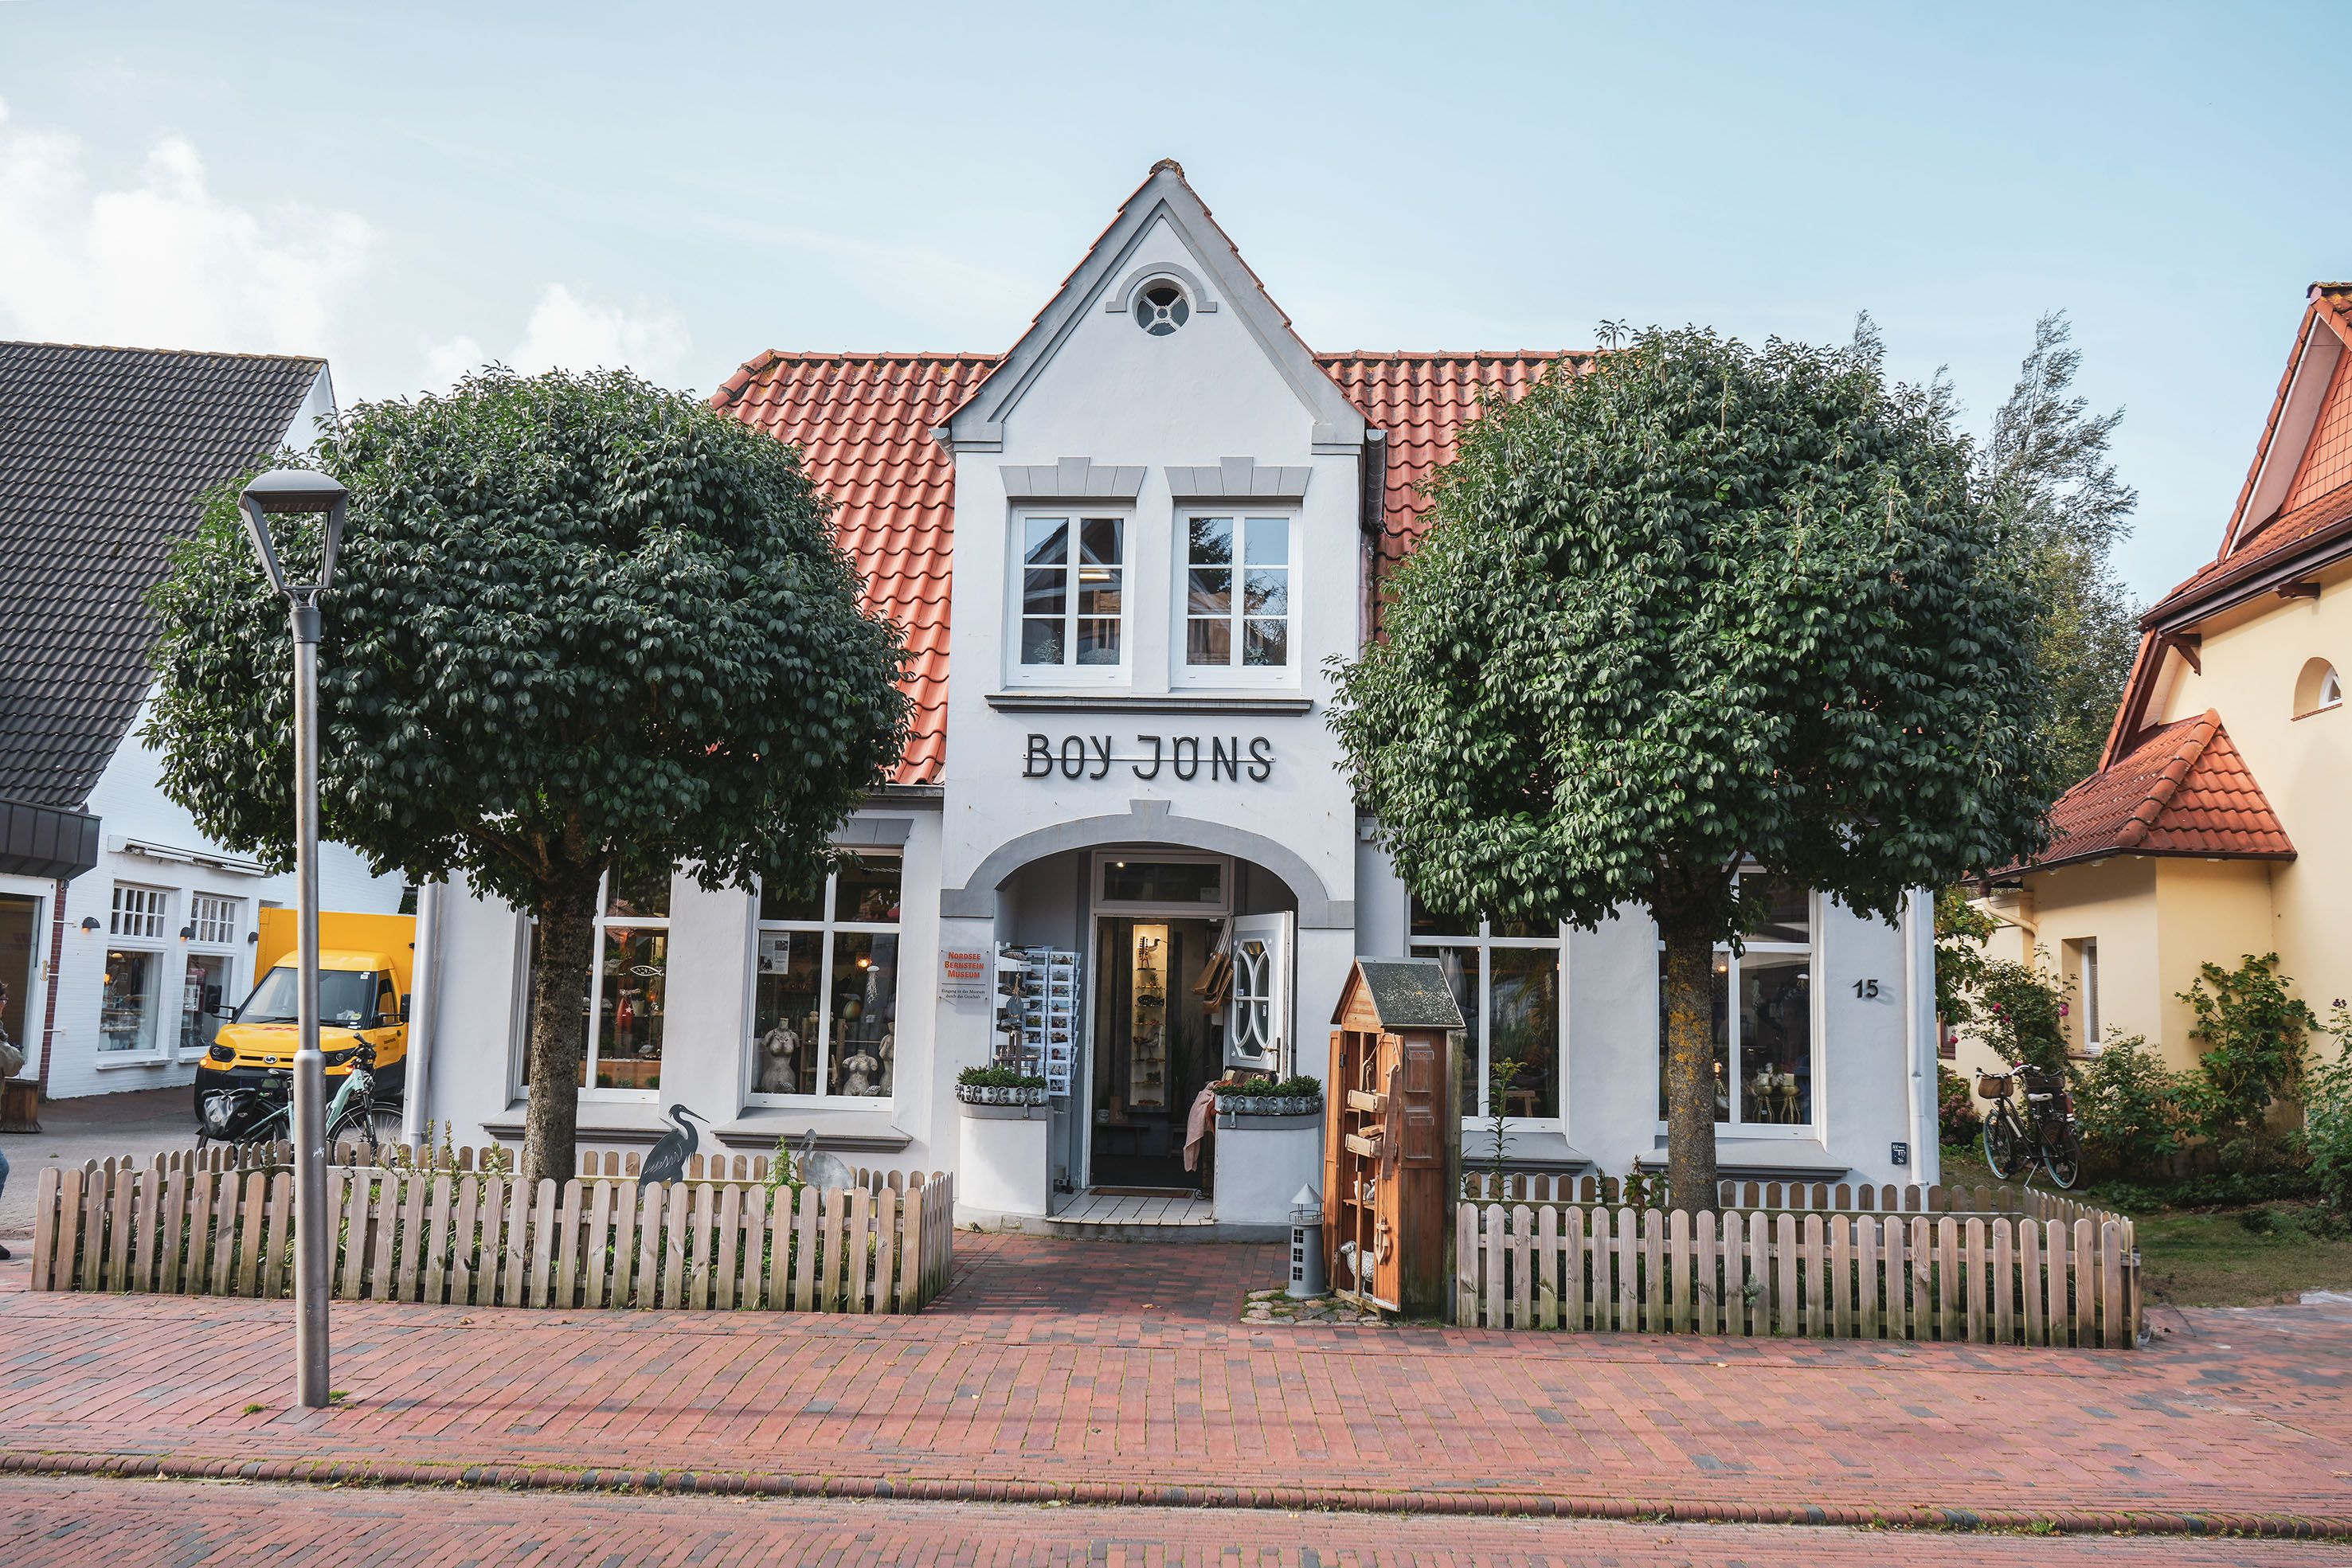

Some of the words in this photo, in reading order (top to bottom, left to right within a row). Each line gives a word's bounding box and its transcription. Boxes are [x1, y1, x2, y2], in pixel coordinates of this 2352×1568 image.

[1022, 733, 1111, 780] BOY
[949, 951, 981, 960] NORDSEE
[945, 960, 984, 969] BERNSTEIN
[1852, 979, 1879, 999] 15
